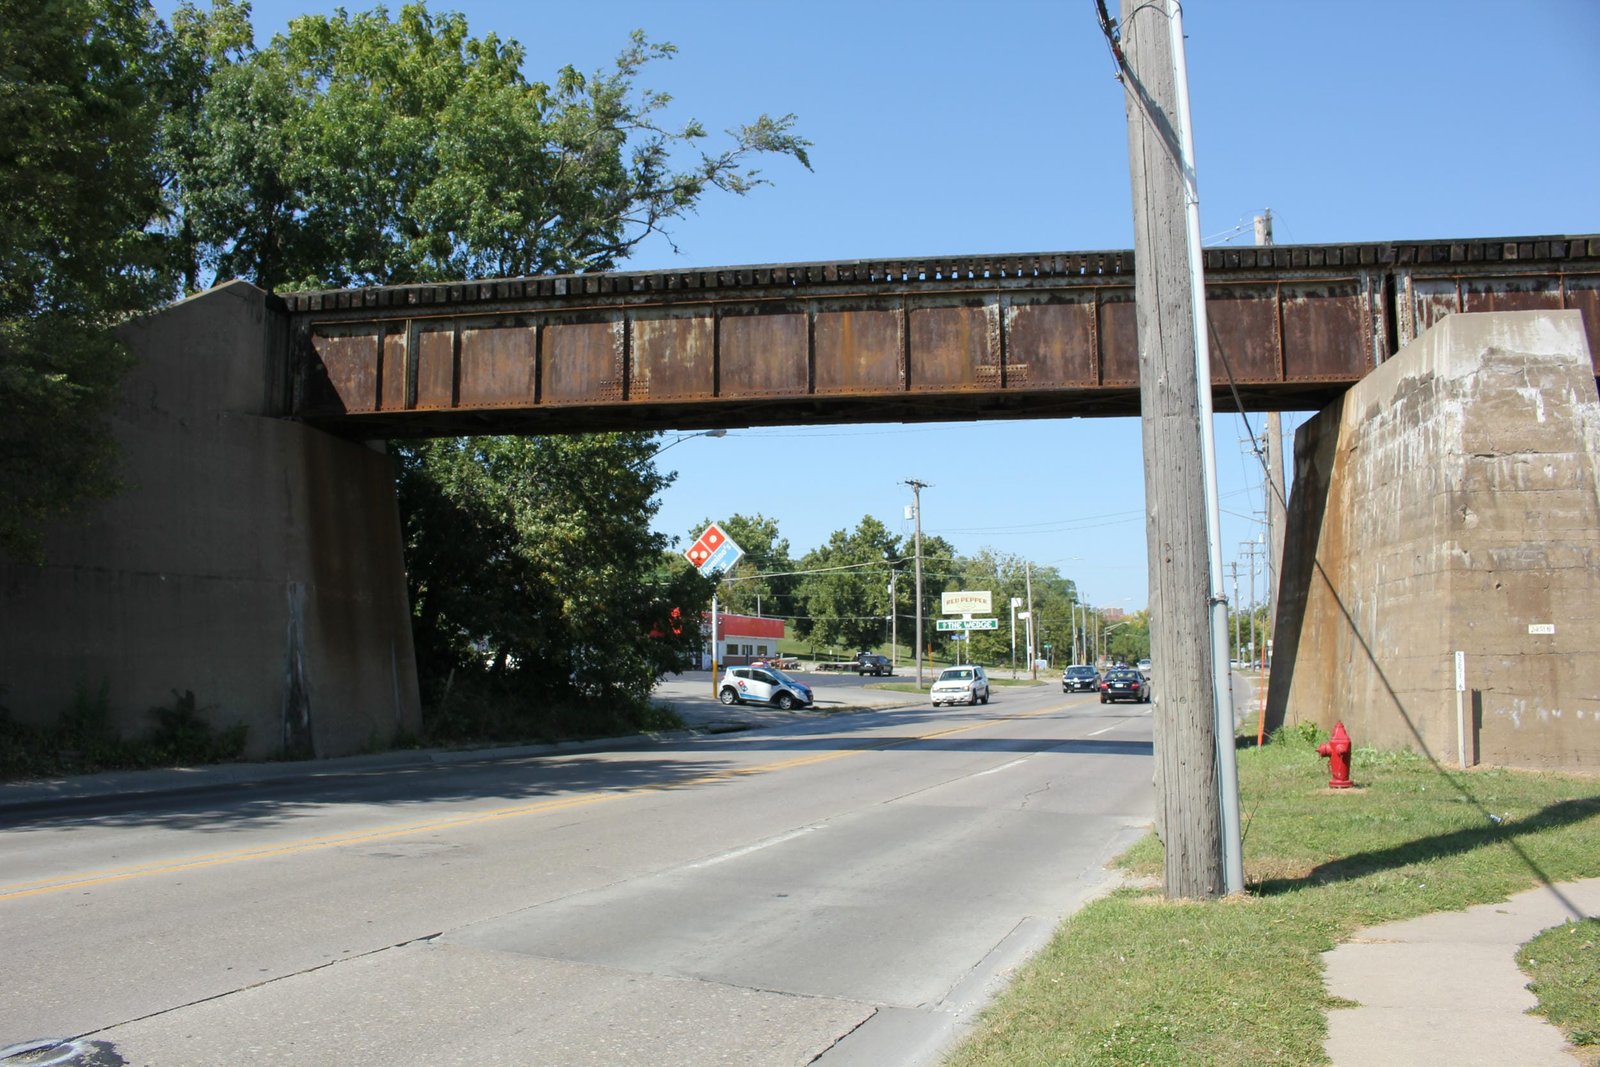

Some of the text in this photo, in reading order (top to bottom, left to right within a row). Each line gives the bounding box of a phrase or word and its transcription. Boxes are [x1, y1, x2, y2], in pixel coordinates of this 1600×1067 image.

[960, 596, 988, 604] PEPPER
[948, 620, 992, 629] THE WEDGE
